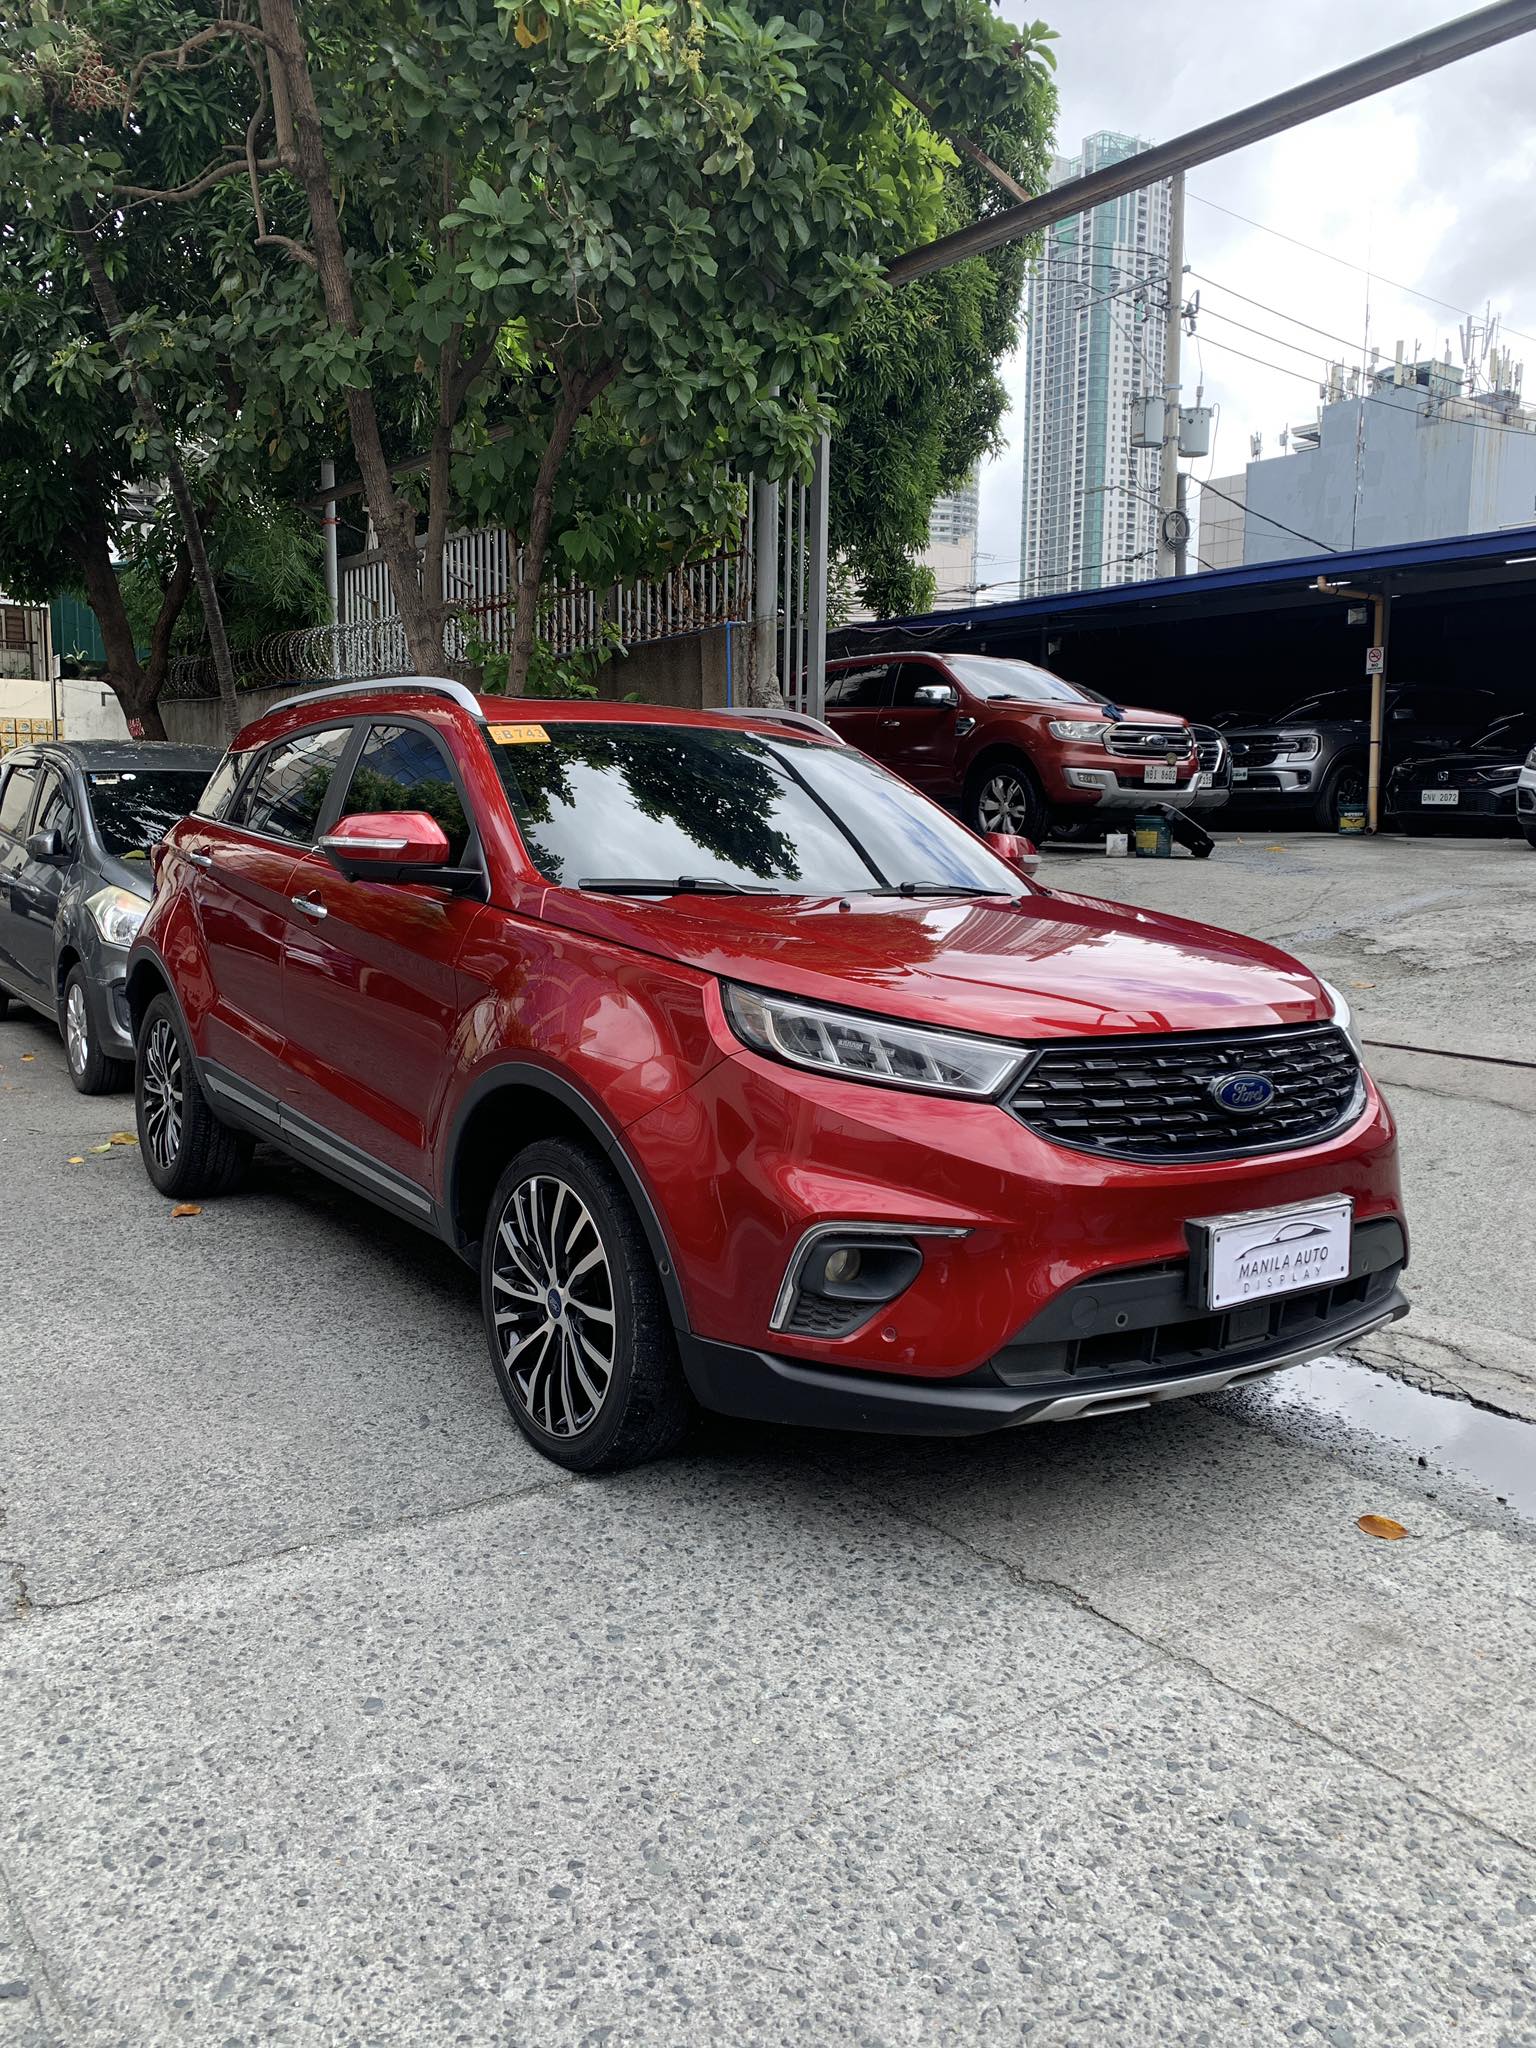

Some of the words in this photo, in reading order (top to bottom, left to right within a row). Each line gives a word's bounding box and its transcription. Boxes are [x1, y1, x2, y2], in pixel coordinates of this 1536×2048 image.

[1232, 1082, 1264, 1104] Ford
[1238, 1254, 1290, 1280] MANILA
[1294, 1246, 1329, 1269] AUTO
[1243, 1266, 1323, 1294] DISPLAY
